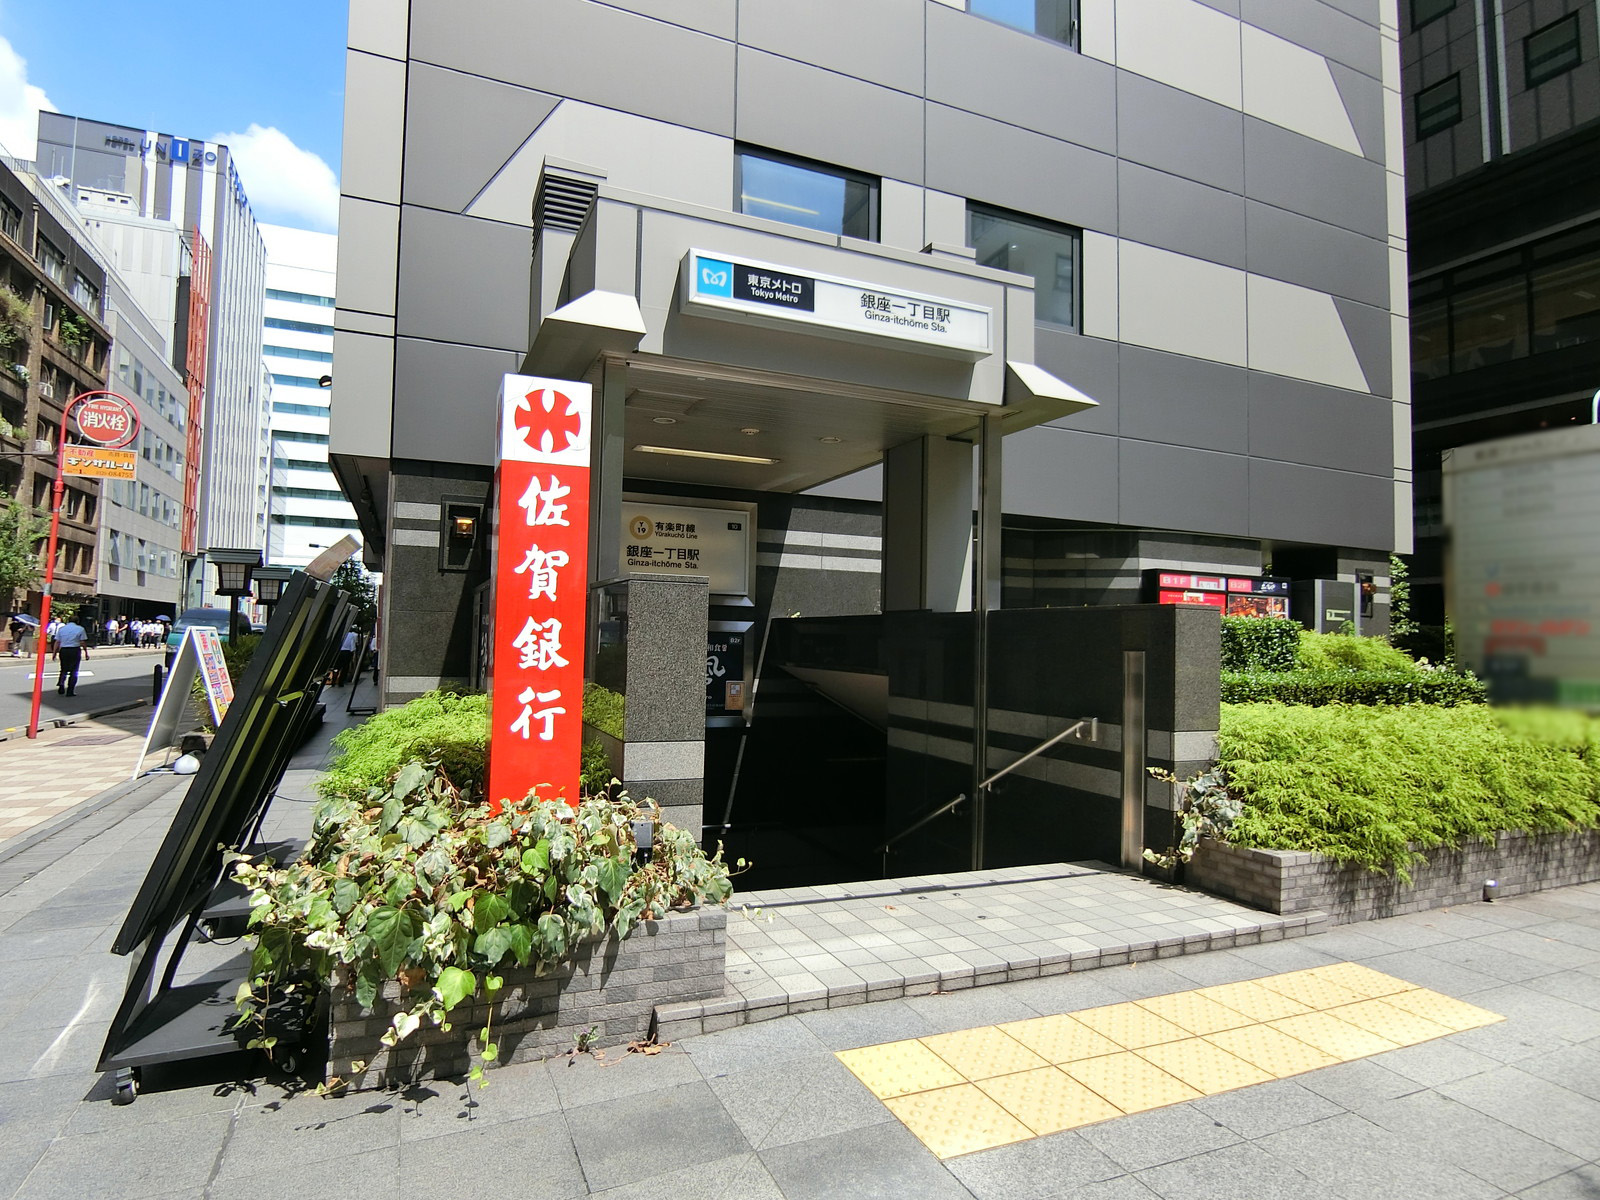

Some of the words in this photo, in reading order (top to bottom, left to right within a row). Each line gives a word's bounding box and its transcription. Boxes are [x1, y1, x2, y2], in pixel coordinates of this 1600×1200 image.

[141, 138, 217, 163] UNIZO
[747, 273, 802, 295] 東京メトロ
[750, 286, 774, 299] Tokyo
[775, 291, 799, 303] Metro
[860, 293, 951, 324] 銀座一丁目駅
[930, 322, 948, 333] Sta.
[82, 410, 126, 431] 消火栓
[655, 521, 696, 533] 有楽町線
[626, 545, 700, 561] 銀座一丁目駅
[684, 561, 699, 570] Sta.
[1162, 576, 1187, 585] B1F
[1230, 581, 1249, 590] B2F
[510, 474, 572, 742] 佐賀銀行
